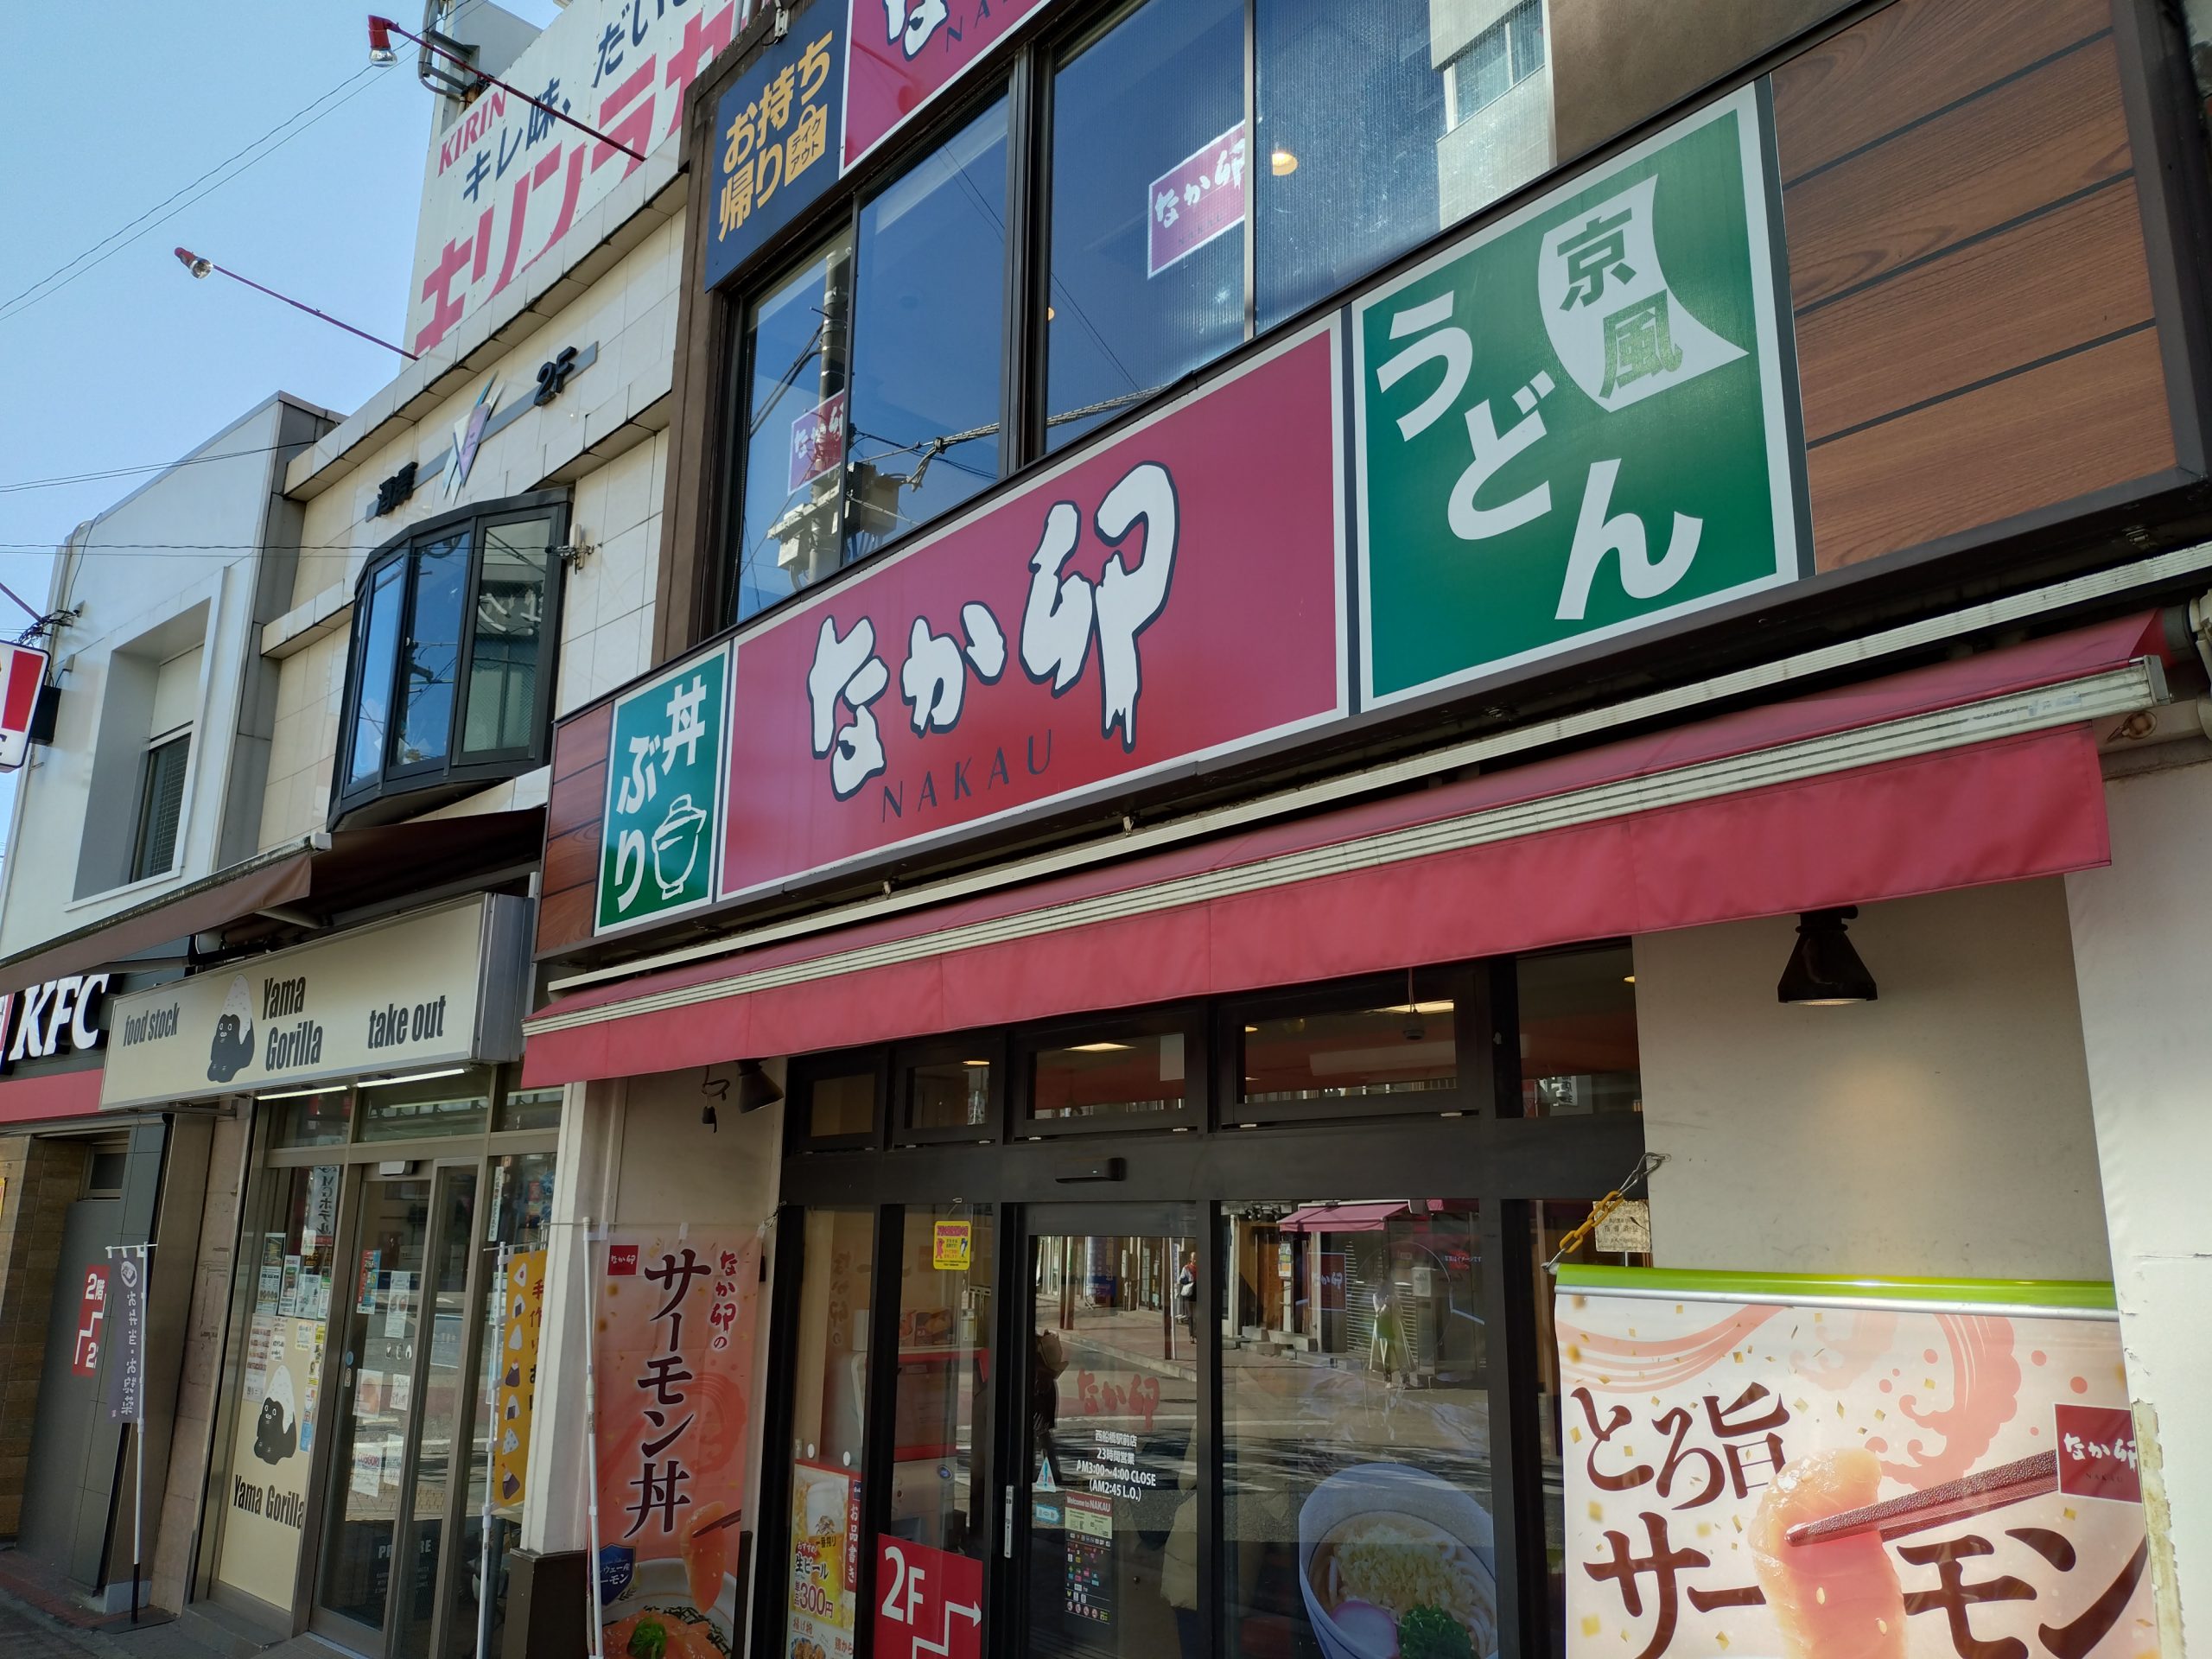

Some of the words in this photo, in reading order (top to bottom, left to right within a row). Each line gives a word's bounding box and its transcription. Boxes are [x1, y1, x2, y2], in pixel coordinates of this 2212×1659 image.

[721, 30, 832, 173] お持ち
[437, 90, 508, 178] KIRIN
[790, 141, 819, 175] アウト
[718, 143, 785, 243] 帰り
[1155, 138, 1245, 228] なか卯
[1556, 207, 1683, 399] 京風
[533, 346, 577, 407] 2F
[1376, 289, 1703, 620] うどん
[807, 461, 1180, 802] なか卯
[615, 675, 709, 913] 丼ぶり
[881, 729, 1053, 823] NAKAU
[8, 974, 110, 1061] KFC
[123, 1009, 148, 1046] food
[148, 1002, 180, 1040] stock
[263, 976, 306, 1020] Yama
[367, 1002, 407, 1050] take
[411, 995, 446, 1039] out
[265, 1020, 323, 1072] Gorilla
[611, 1255, 636, 1265] なか卯
[709, 1249, 738, 1351] なか卯の
[624, 1248, 713, 1539] サーモン丼
[1077, 1369, 1160, 1433] なか卯
[1095, 1429, 1138, 1448] 西船橋駅前店
[1096, 1447, 1135, 1465] 23時間営業
[1571, 1382, 1790, 1510] とろ旨
[2063, 1433, 2137, 1472] なか卯
[233, 1474, 262, 1516] Yama
[266, 1485, 304, 1531] Gorilla
[1066, 1496, 1085, 1507] Welcome
[1090, 1499, 1111, 1512] NAKAU
[1089, 1478, 1122, 1497] (AM2:45
[1122, 1484, 1142, 1503] L.O.)
[1130, 1470, 1156, 1487] CLOSE
[795, 1554, 829, 1580] 生ビール
[816, 1535, 836, 1548] 一番搾り
[848, 1504, 859, 1584] お品書き
[591, 1573, 629, 1585] ーモン
[800, 1583, 833, 1619] 300円
[881, 1547, 925, 1625] 2F
